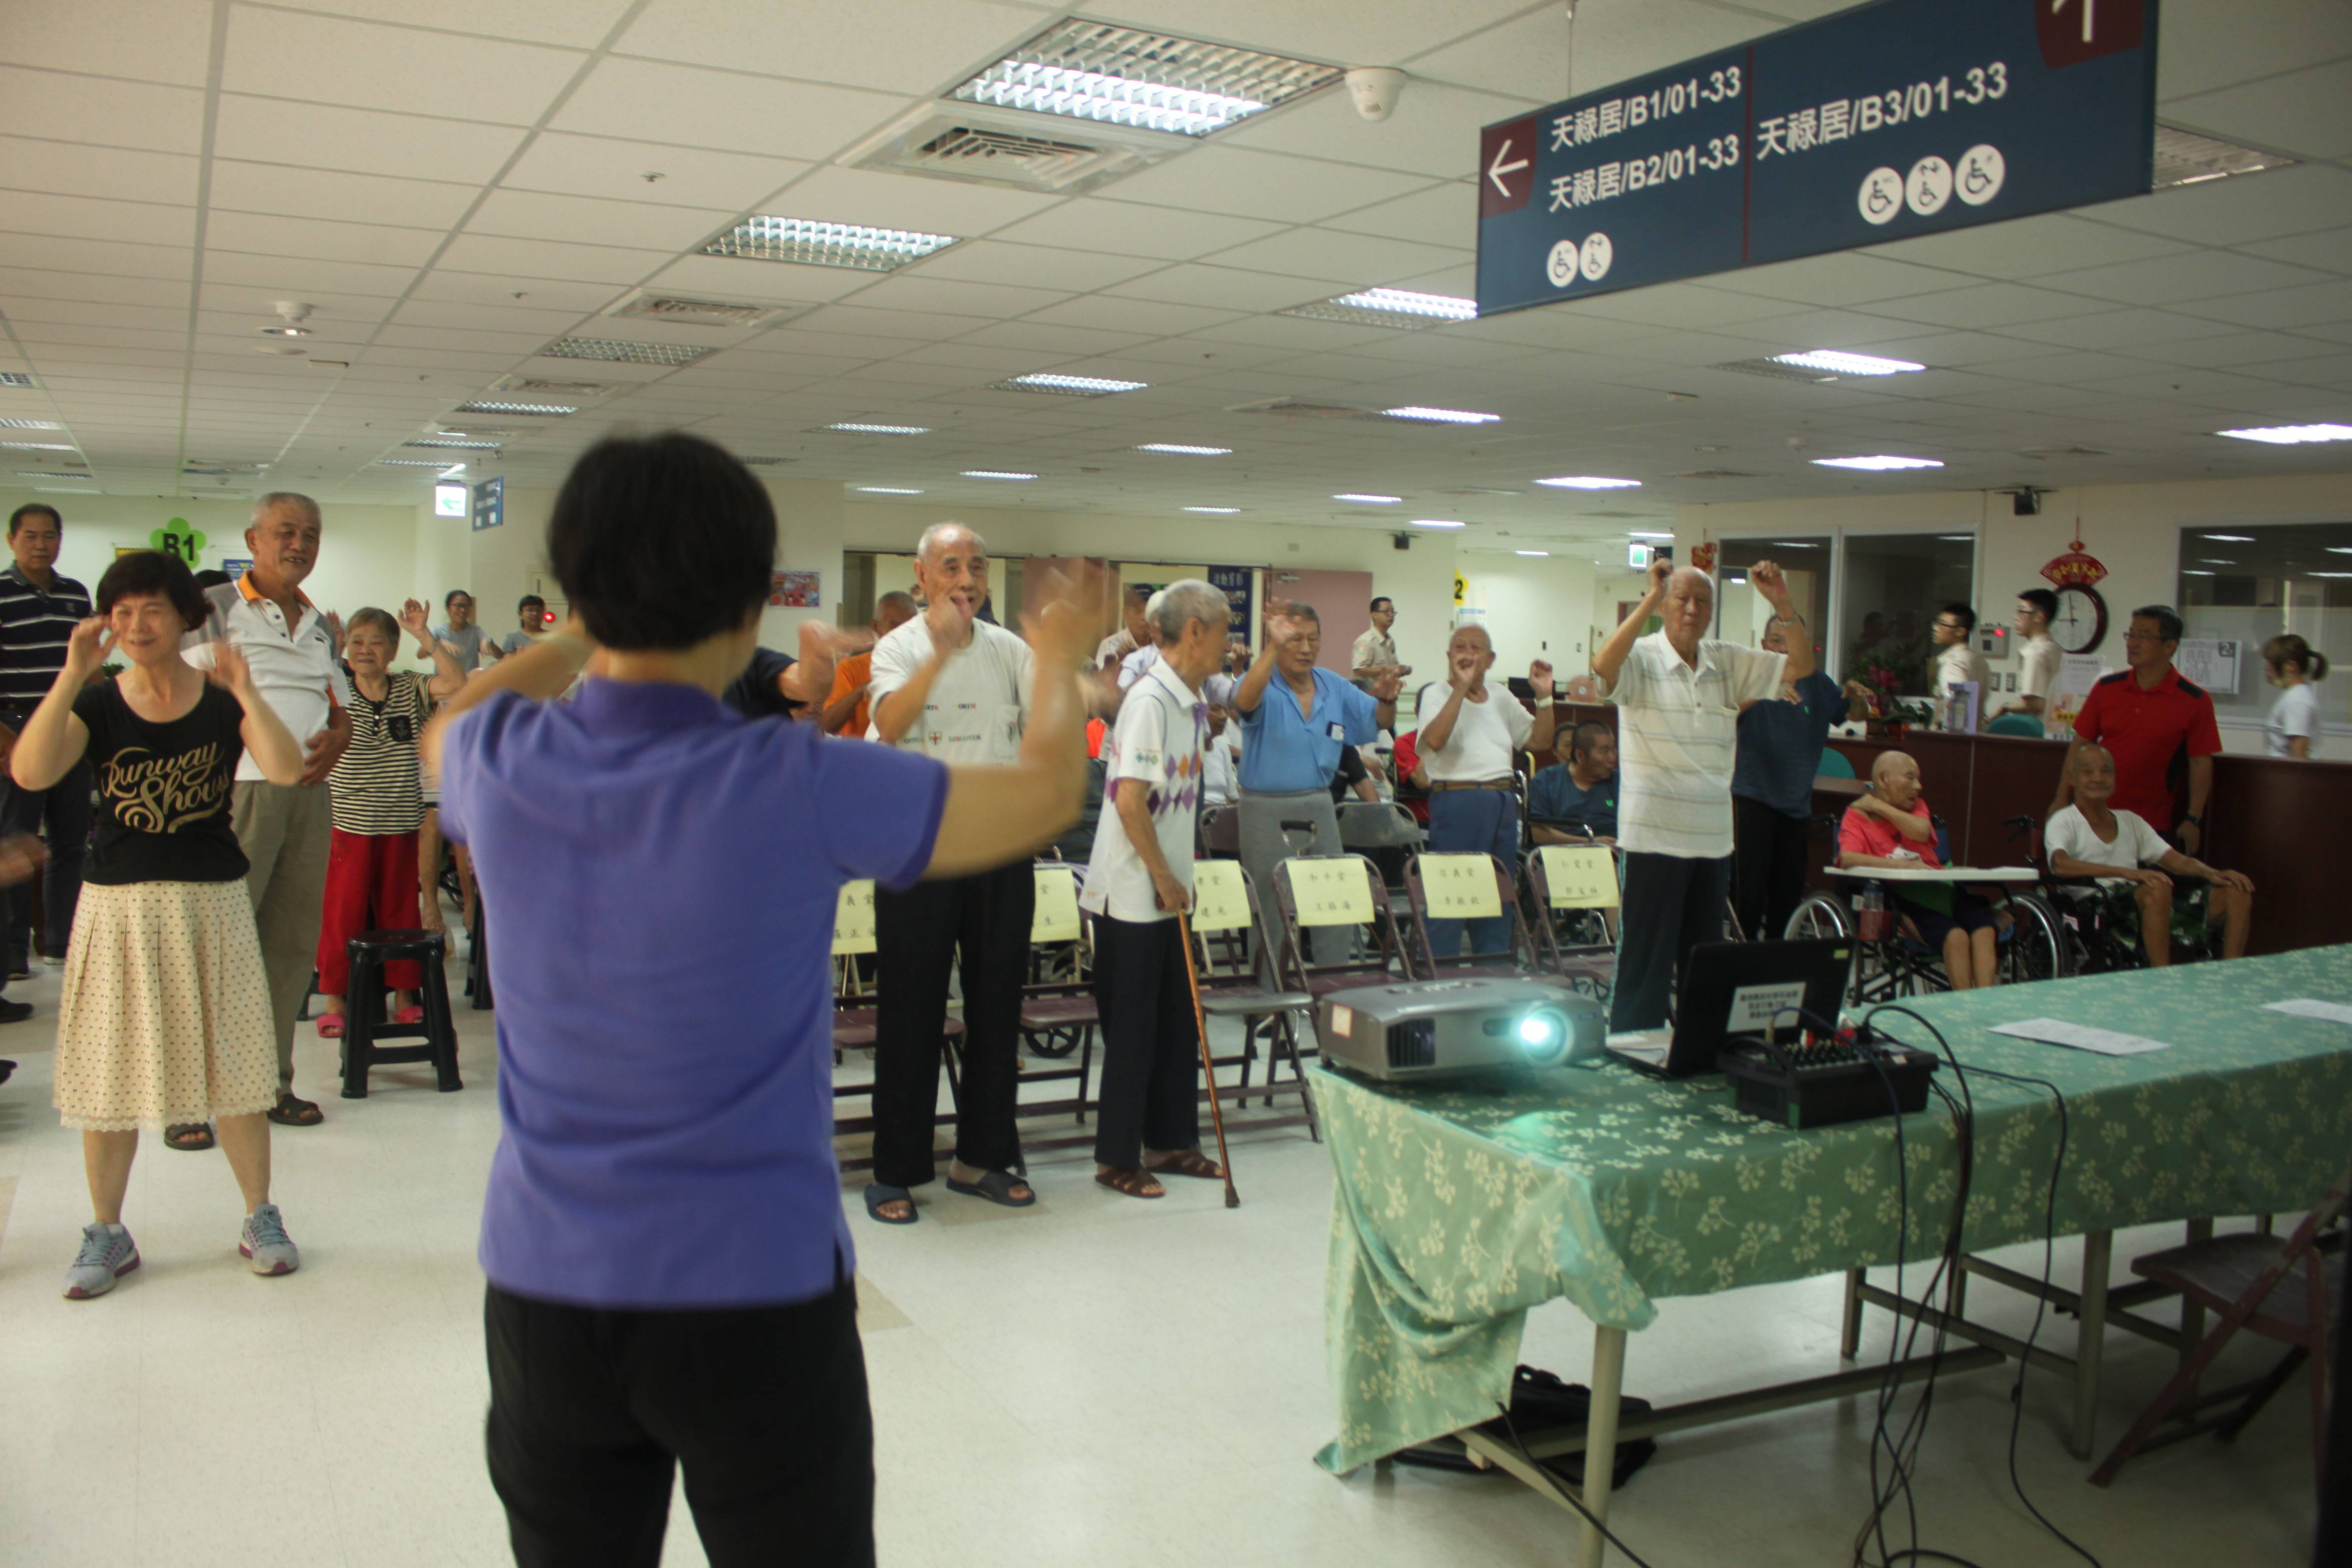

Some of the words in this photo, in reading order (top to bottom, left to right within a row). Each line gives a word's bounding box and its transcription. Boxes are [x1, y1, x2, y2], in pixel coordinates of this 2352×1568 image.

[1551, 66, 1741, 152] 天祿居/B1/01-33
[1756, 61, 2008, 160] 天祿居/B3/01-33
[1549, 134, 1740, 213] 天祿居/B2/01-33
[163, 533, 195, 561] B1
[101, 741, 225, 798] Runway
